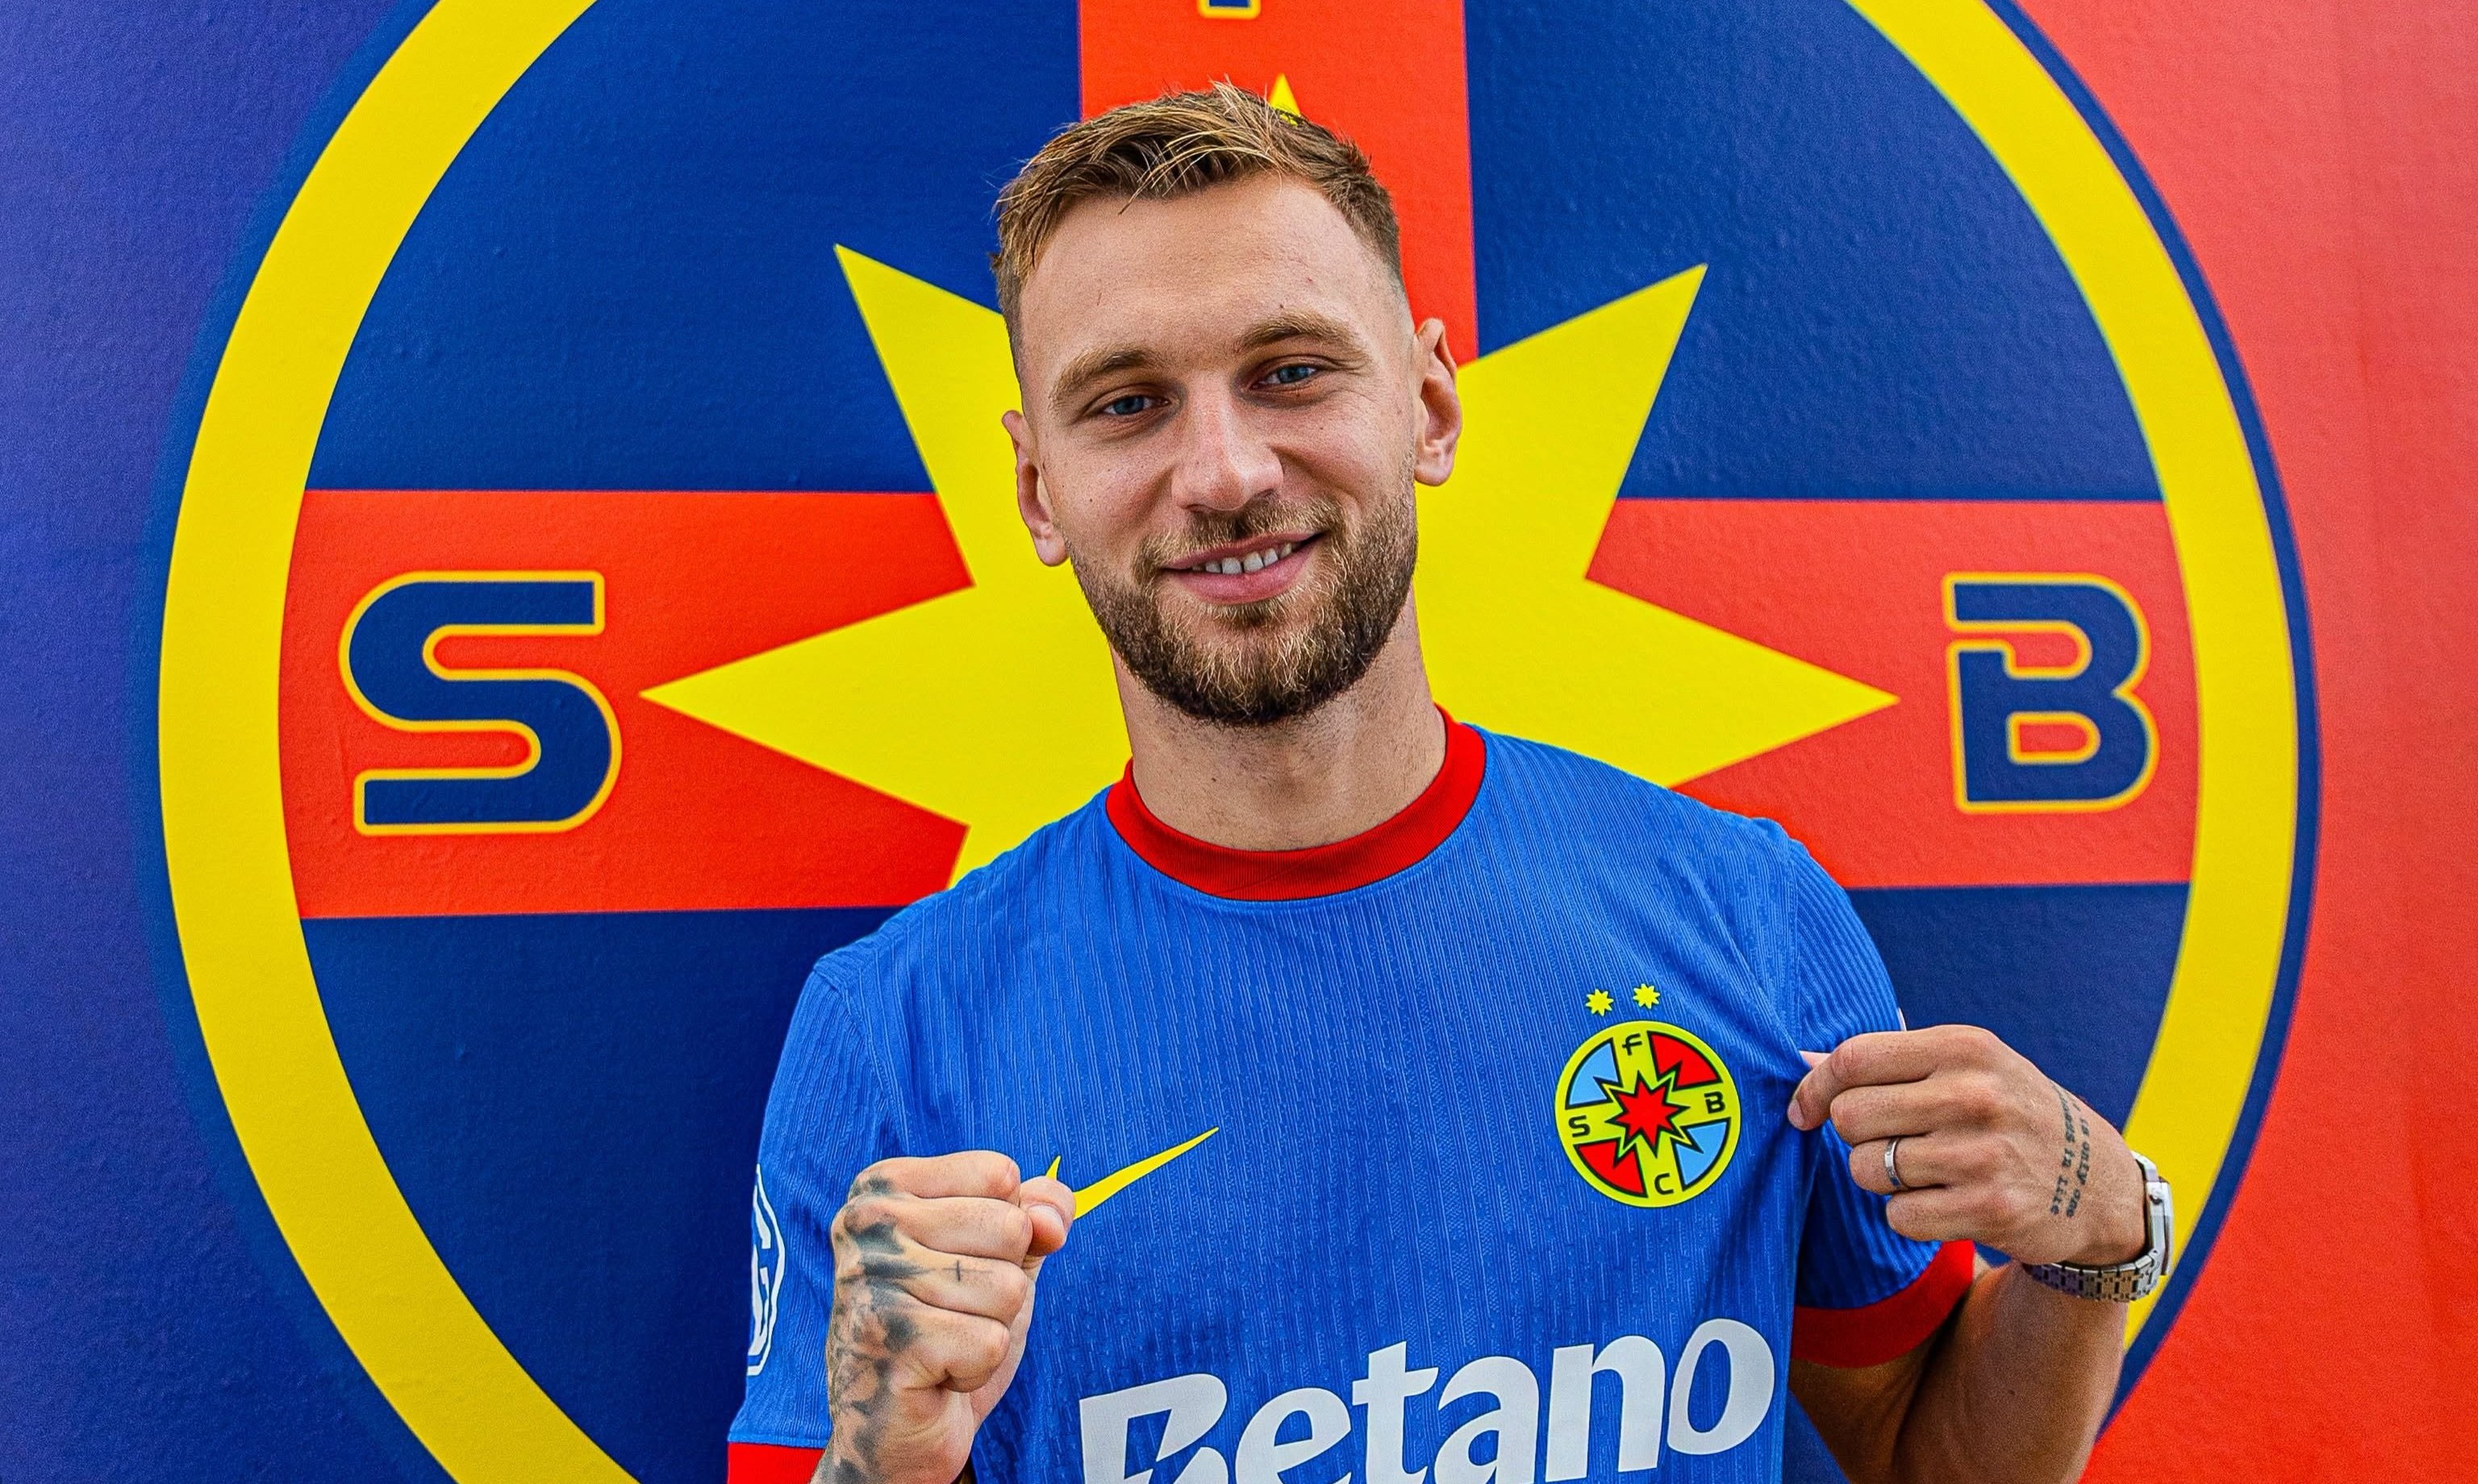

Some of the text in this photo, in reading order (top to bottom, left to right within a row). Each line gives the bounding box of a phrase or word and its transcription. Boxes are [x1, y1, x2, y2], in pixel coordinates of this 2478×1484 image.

[339, 570, 622, 836] S
[1941, 571, 2160, 814] B
[1568, 1115, 1591, 1137] S
[1704, 1091, 1725, 1114] B
[1654, 1173, 1675, 1195] C
[1079, 1319, 1775, 1484] Betano
